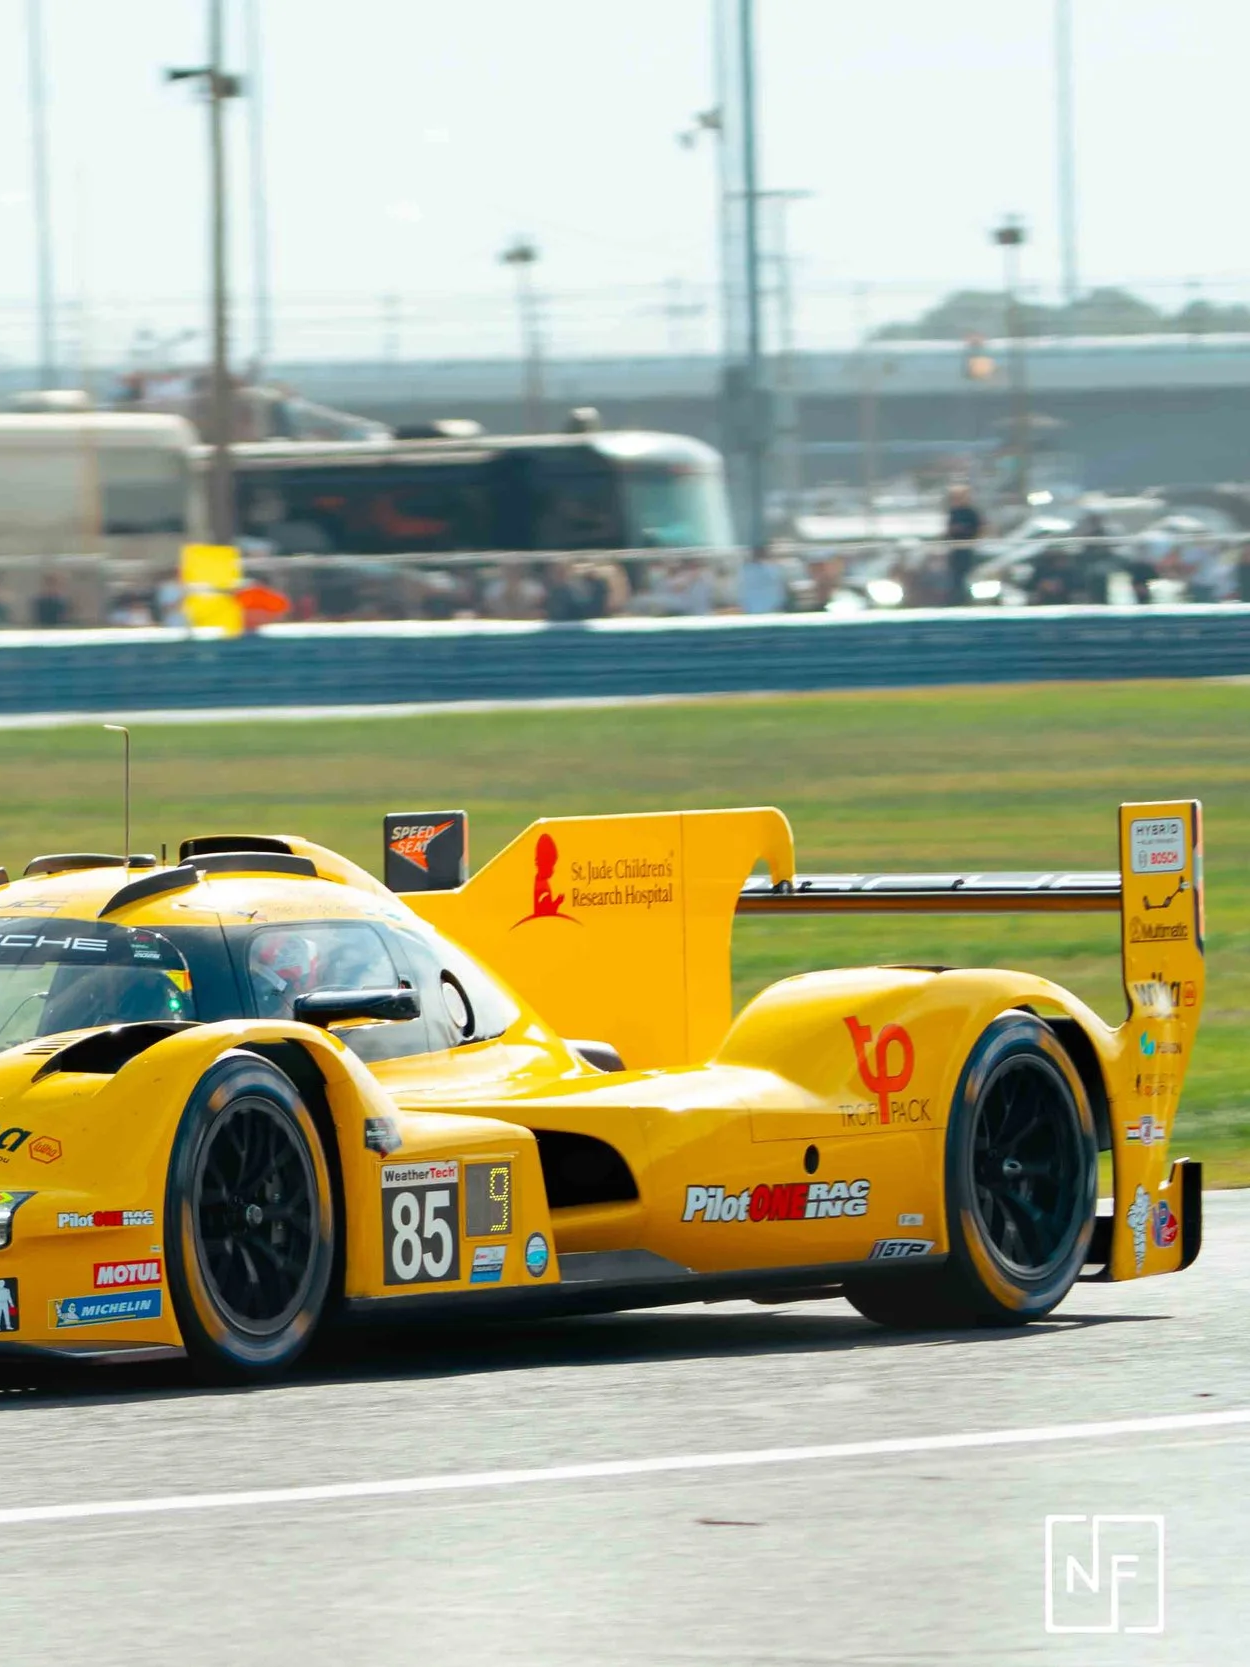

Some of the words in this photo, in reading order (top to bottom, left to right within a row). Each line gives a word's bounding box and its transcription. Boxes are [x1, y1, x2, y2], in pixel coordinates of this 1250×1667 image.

[391, 826, 435, 840] SPEED
[1136, 824, 1178, 836] HYBRID
[398, 841, 428, 853] SEAT
[1150, 852, 1178, 865] BOSCH
[571, 862, 586, 881] St.
[586, 860, 613, 886] Jude
[615, 858, 672, 879] Children's
[572, 887, 622, 907] Research
[625, 883, 673, 909] Hospital
[891, 1098, 932, 1123] PACK
[384, 1167, 455, 1183] WeatherTech
[489, 1167, 510, 1232] 9
[391, 1190, 453, 1281] 85
[97, 1263, 160, 1285] MOTUL
[81, 1300, 152, 1317] MICHELIN
